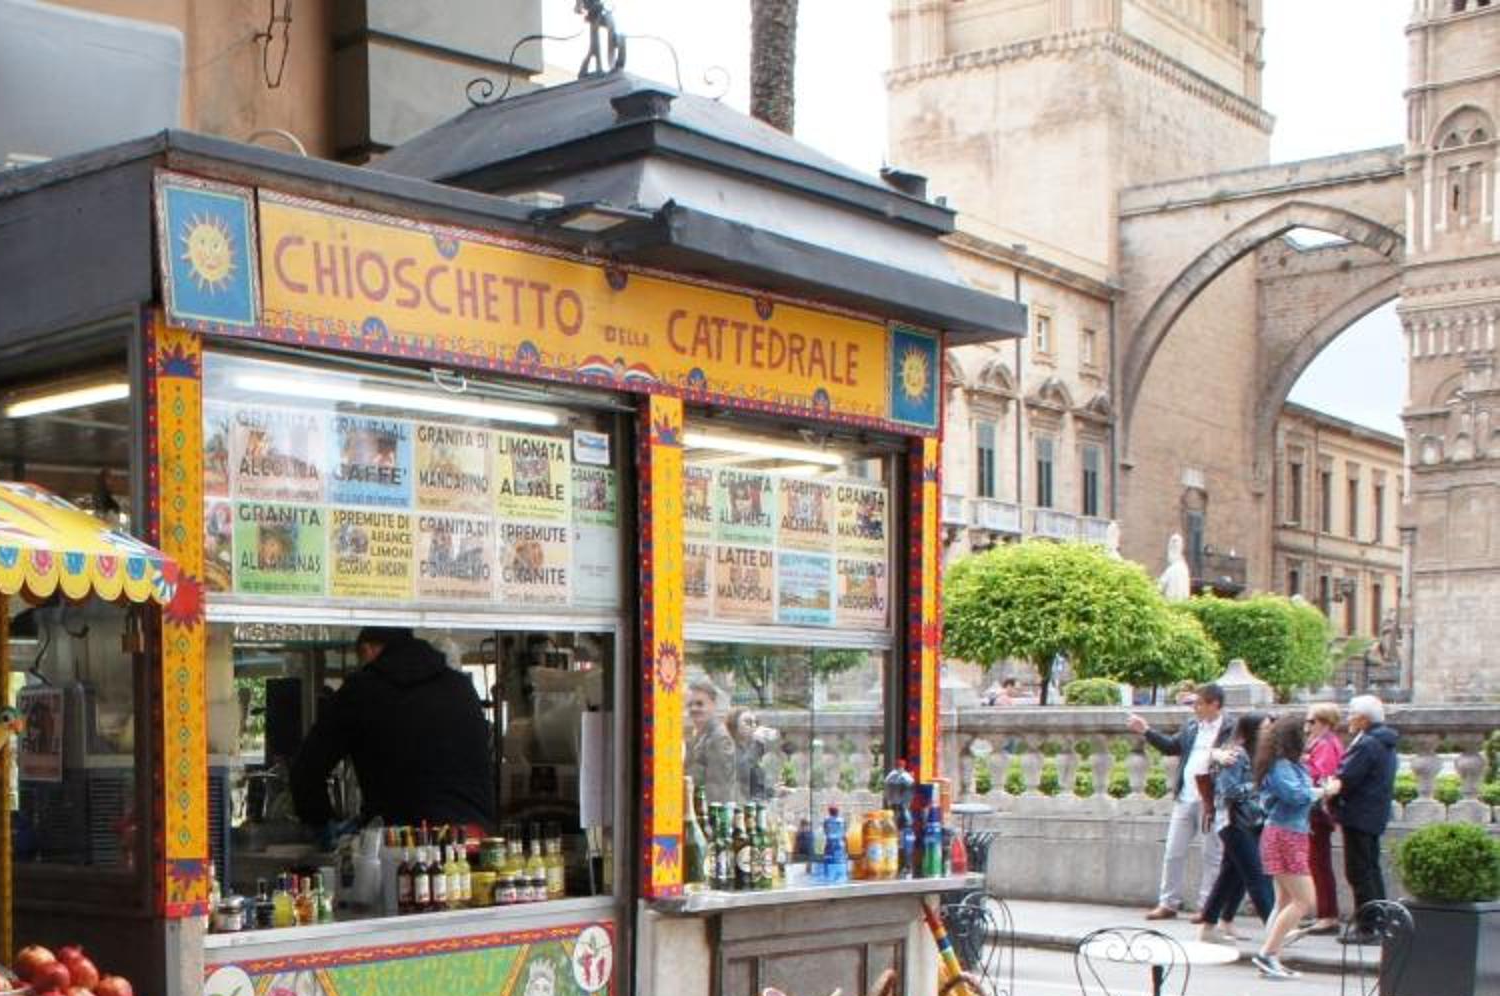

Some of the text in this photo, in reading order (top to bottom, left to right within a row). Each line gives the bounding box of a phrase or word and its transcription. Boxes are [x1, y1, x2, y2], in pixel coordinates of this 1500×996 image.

[273, 230, 860, 387] CHIOSCHETTO DELLA CATTEDRALE
[418, 425, 474, 447] GRANITA
[499, 436, 565, 463] LIMONATA
[238, 503, 321, 527] GRANITA
[333, 510, 410, 530] SPREMUTE DI
[418, 515, 474, 537] GRANITA
[500, 521, 567, 543] SPREMUTE
[370, 546, 413, 560] LIMONI
[717, 545, 757, 568] LATTE
[501, 566, 566, 586] GRANITE
